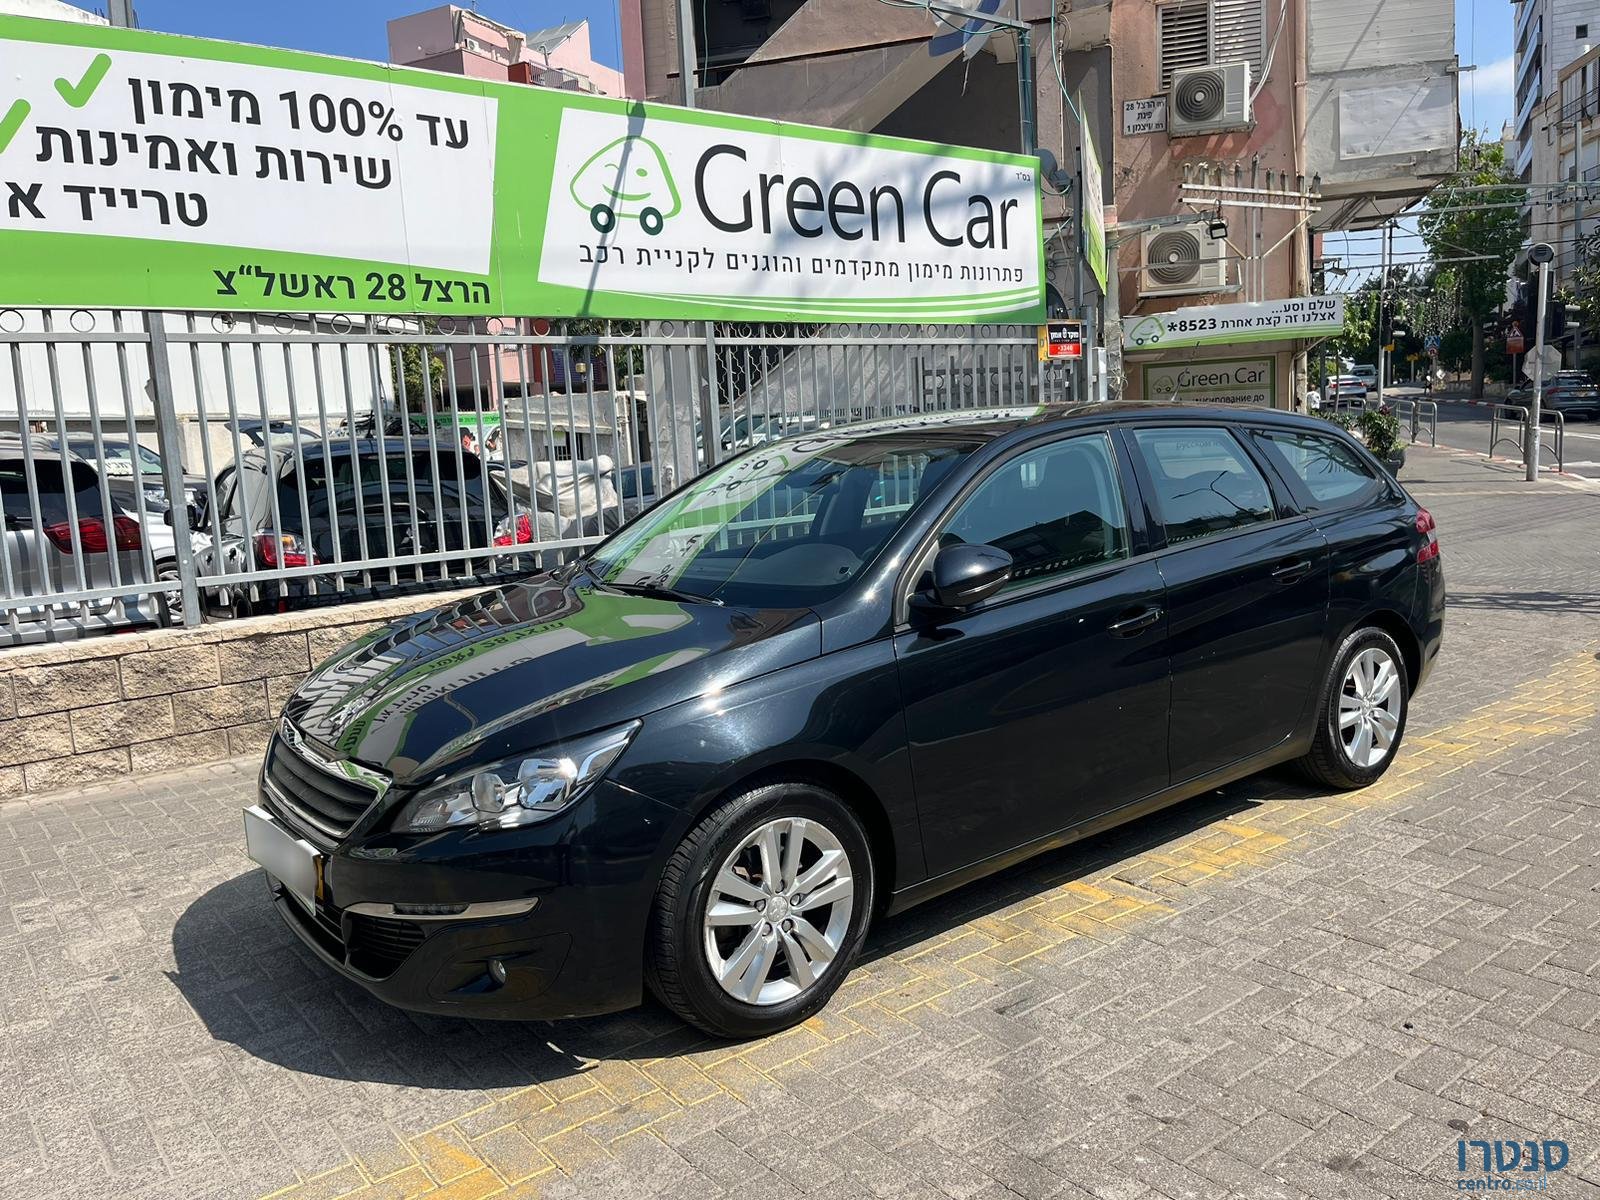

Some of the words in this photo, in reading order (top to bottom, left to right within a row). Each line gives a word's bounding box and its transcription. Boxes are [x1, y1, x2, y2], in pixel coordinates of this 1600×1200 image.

[128, 78, 261, 125] מימון
[1125, 103, 1135, 111] 28
[280, 91, 403, 142] 100%
[417, 114, 468, 149] עד
[36, 127, 238, 176] ואמינות
[256, 146, 392, 190] שירות
[64, 185, 208, 227] טרייד
[694, 144, 906, 243] Green
[923, 171, 1018, 250] Car
[580, 244, 625, 265] רכב
[637, 247, 715, 274] לקניית
[727, 254, 801, 274] והוגנים
[812, 259, 899, 281] מתקדמים
[908, 263, 953, 283] מימון
[961, 266, 1023, 283] פתרונות
[366, 273, 406, 301] 28
[415, 274, 491, 304] הרצל
[1271, 303, 1304, 314] וסע...
[1308, 299, 1336, 311] שלם
[1221, 319, 1252, 329] אחרת
[1255, 317, 1281, 328] קצת
[1285, 316, 1299, 324] זה
[1302, 311, 1336, 323] אצלנו
[1177, 371, 1230, 388] Green
[1234, 367, 1265, 384] Car
